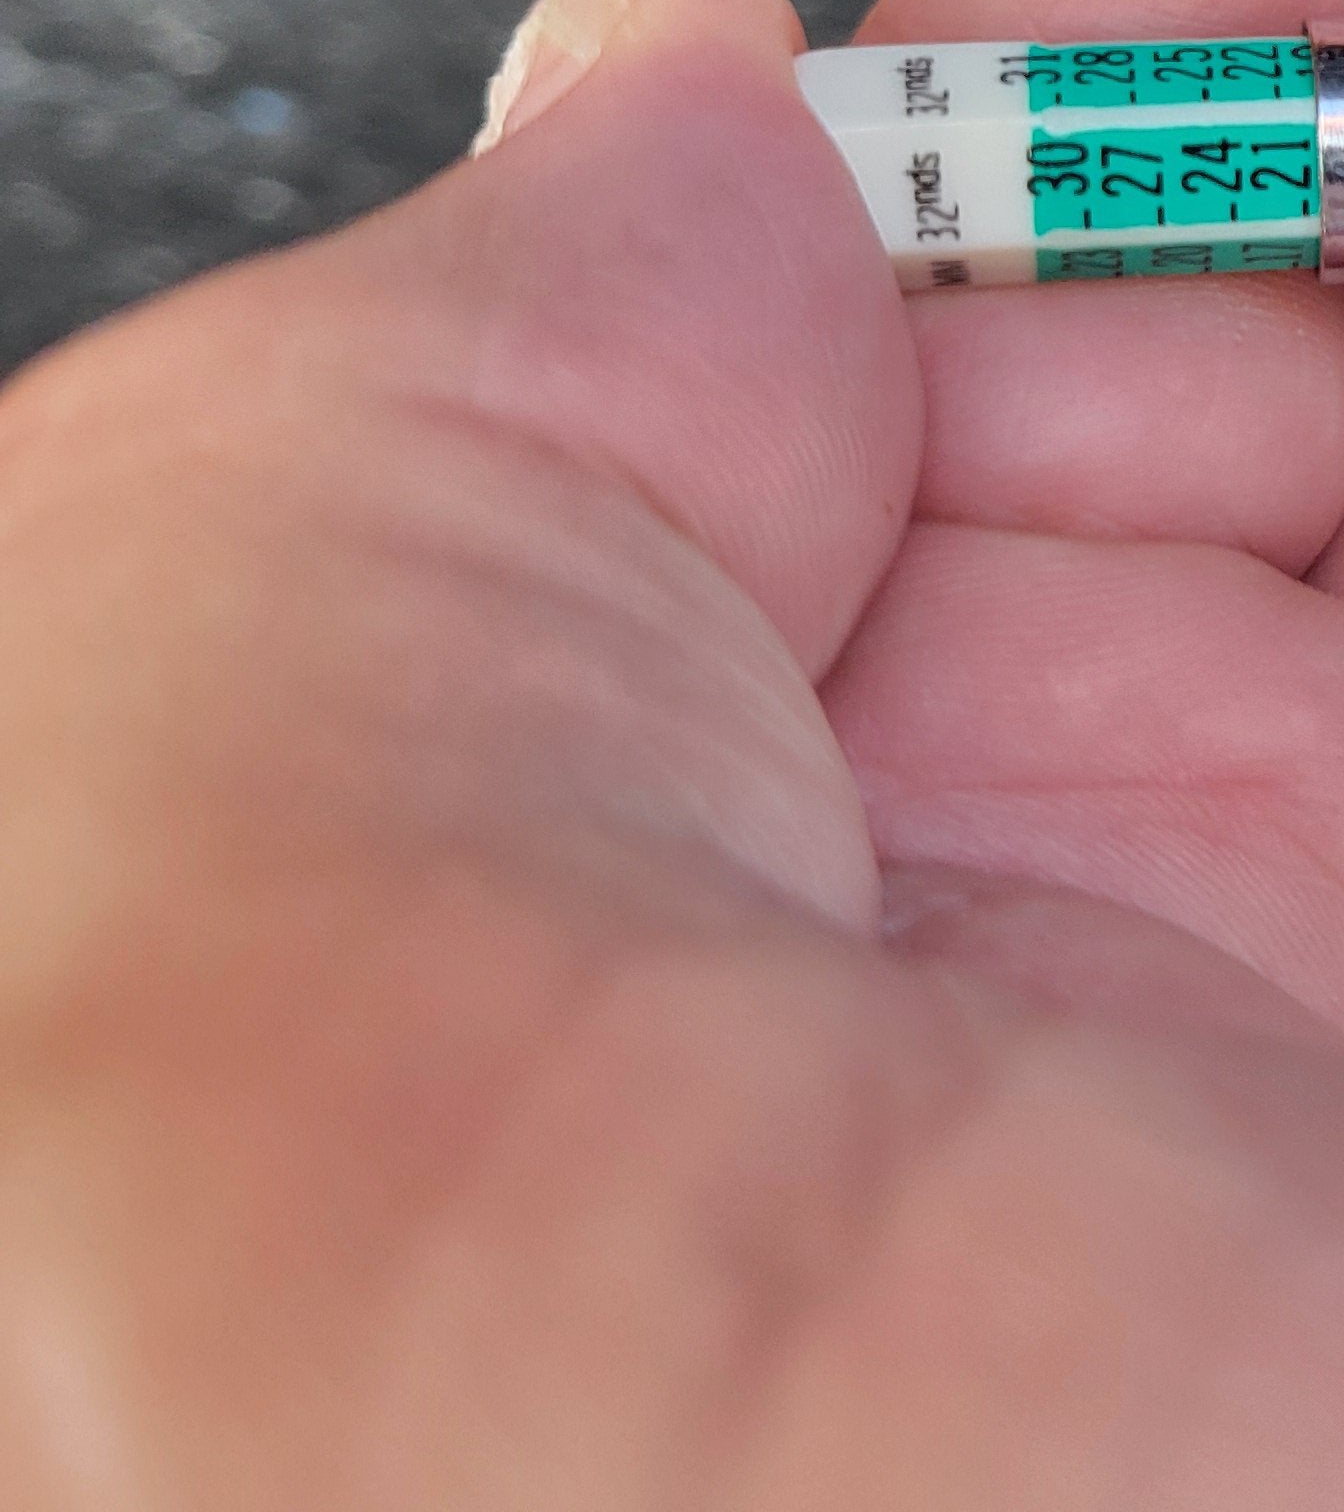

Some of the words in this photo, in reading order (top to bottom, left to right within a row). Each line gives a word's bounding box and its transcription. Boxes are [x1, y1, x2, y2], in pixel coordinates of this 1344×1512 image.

[999, 52, 1062, 85] 31
[1072, 49, 1137, 86] 28
[1153, 47, 1216, 82] 25
[1221, 45, 1284, 80] 22
[1027, 141, 1089, 196] 30
[1101, 146, 1165, 196] 27
[1181, 138, 1243, 194] 24
[1250, 139, 1312, 190] 21
[906, 151, 961, 242] 32nds
